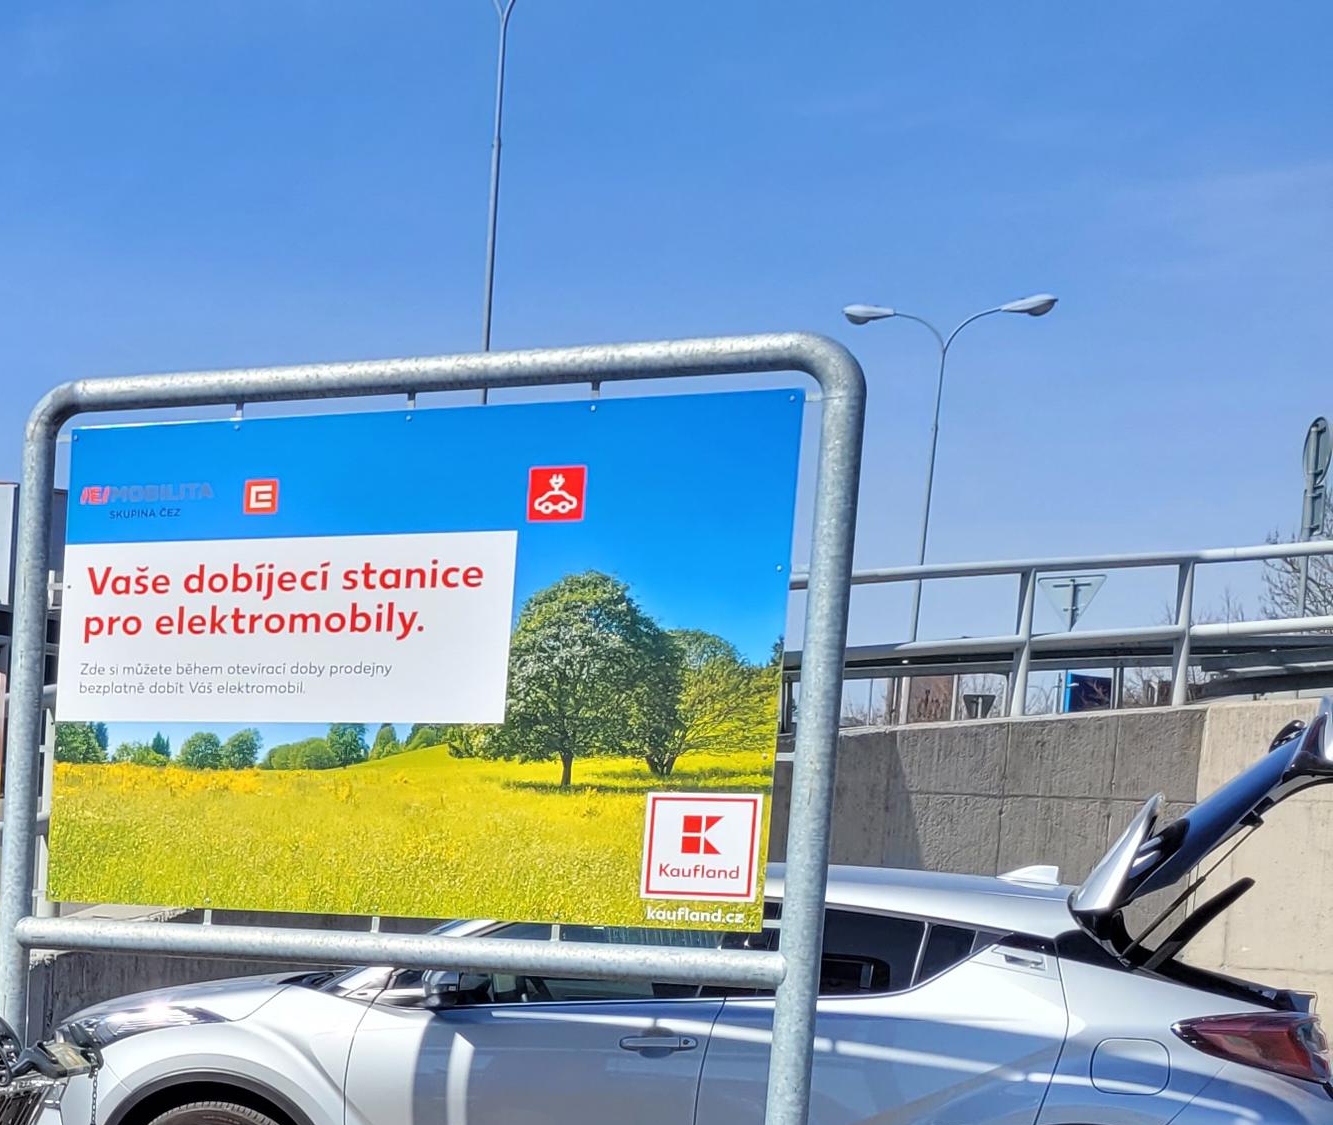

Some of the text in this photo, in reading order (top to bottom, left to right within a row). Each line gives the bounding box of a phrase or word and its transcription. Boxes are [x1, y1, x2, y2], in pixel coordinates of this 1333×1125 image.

[109, 507, 181, 520] SKUPINA ČEZ
[87, 559, 484, 600] Vaše dobíjecí stanice
[83, 602, 425, 644] pro elektromobily.
[80, 663, 106, 676] Zde
[109, 664, 119, 676] si
[123, 662, 172, 676] můžete
[176, 662, 223, 676] během
[290, 662, 325, 678] doby
[329, 663, 392, 678] prodejny
[79, 682, 145, 696] bezplatně
[189, 681, 213, 695] Váš
[217, 681, 305, 695] elektromobil.
[659, 862, 740, 880] Kaufland
[646, 906, 745, 925] kaufland.cz
